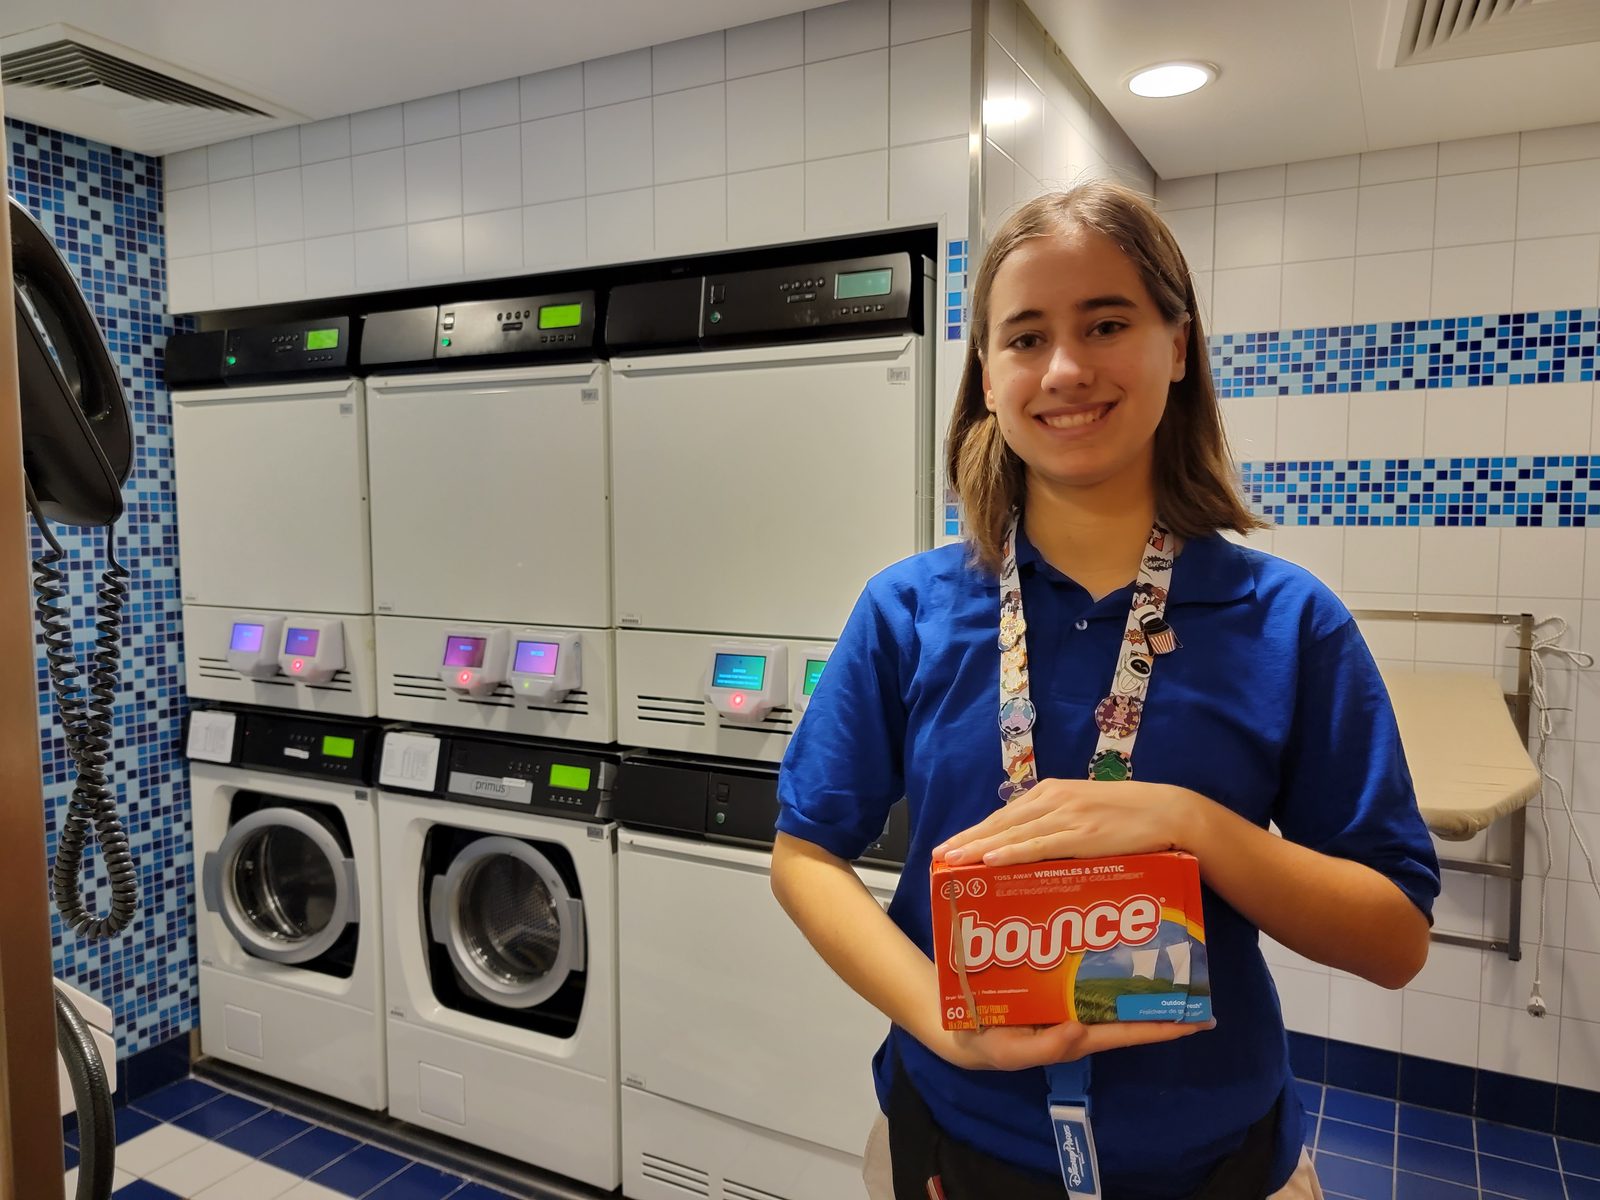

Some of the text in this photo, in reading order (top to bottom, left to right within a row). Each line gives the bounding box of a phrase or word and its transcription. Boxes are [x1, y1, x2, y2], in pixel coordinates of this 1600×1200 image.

[475, 781, 506, 793] primus
[1034, 868, 1083, 879] WRINKLES
[1084, 867, 1091, 875] &
[1092, 865, 1125, 874] STATIC
[955, 898, 1157, 969] bounce
[946, 1006, 965, 1020] 60
